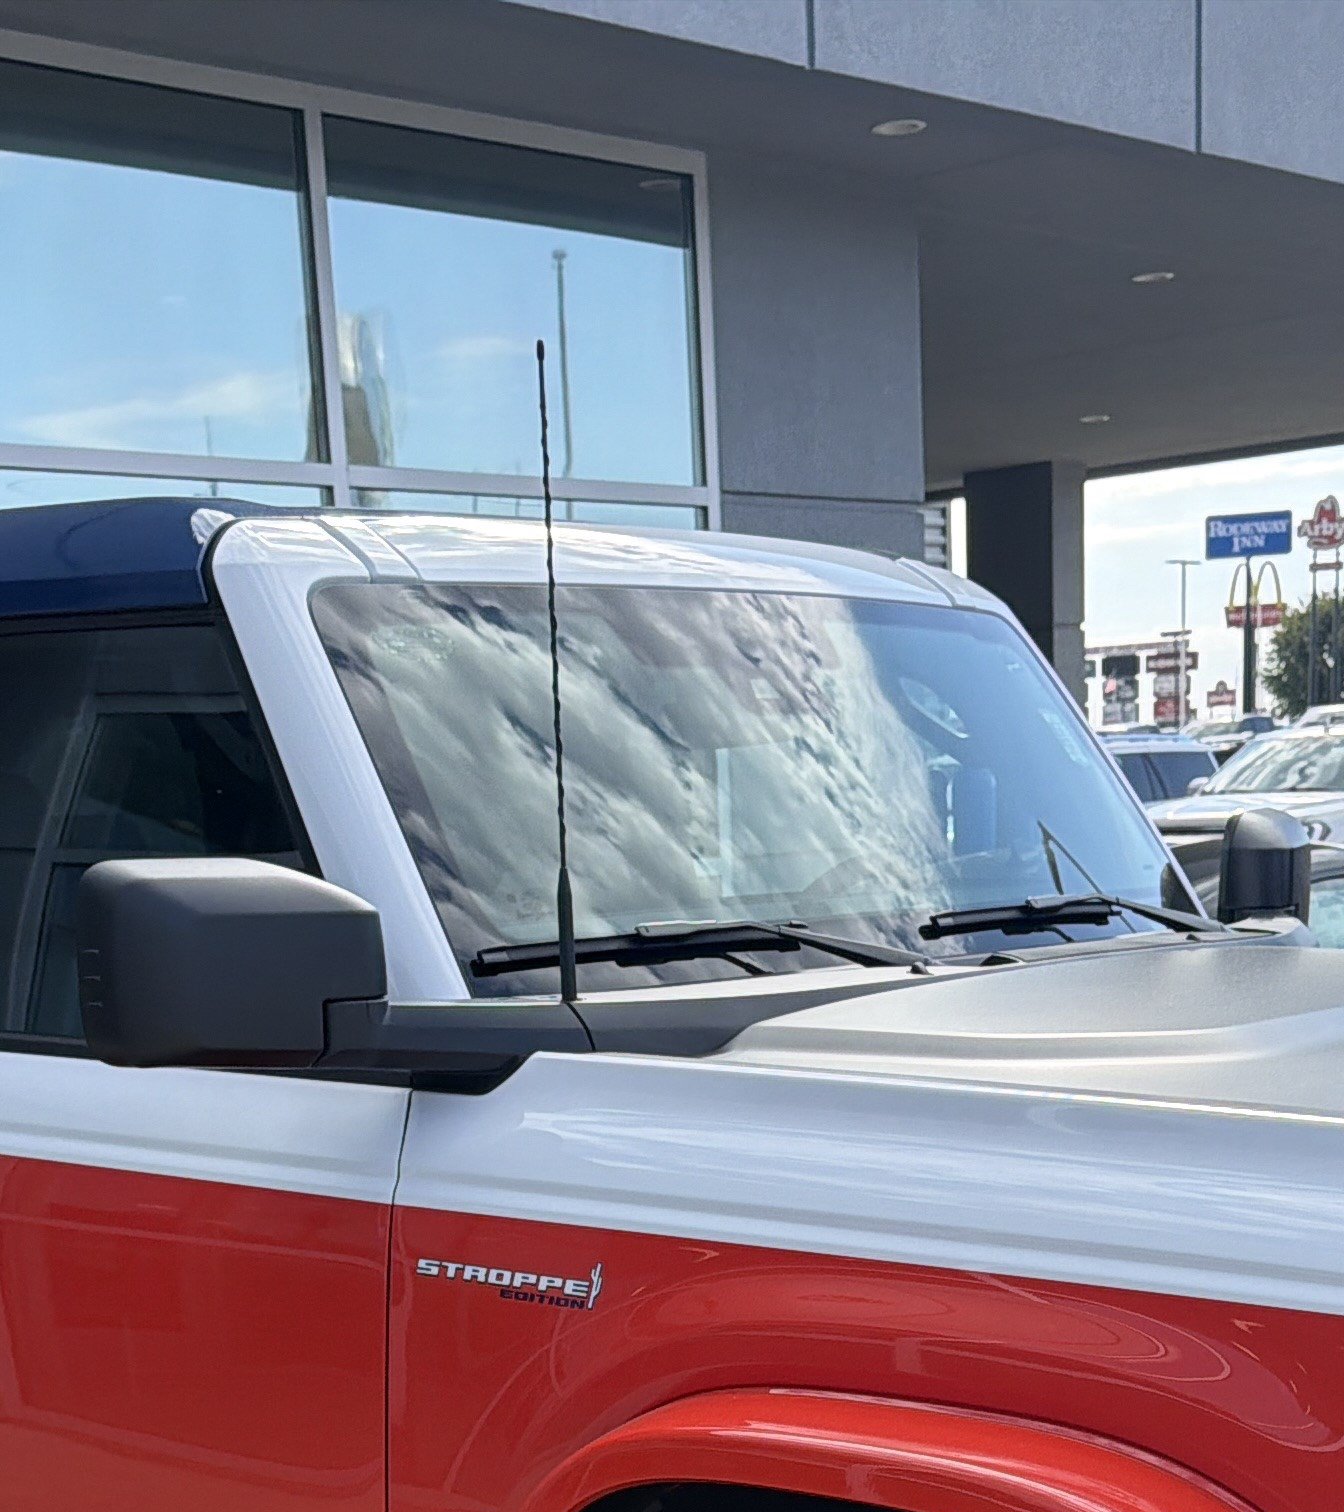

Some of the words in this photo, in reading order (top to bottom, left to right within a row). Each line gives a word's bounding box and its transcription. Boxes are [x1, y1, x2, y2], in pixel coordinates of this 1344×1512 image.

[1209, 519, 1288, 537] RODEWAY
[1232, 534, 1266, 552] INN
[416, 1258, 591, 1298] STROPPE
[499, 1289, 587, 1310] EDITION
